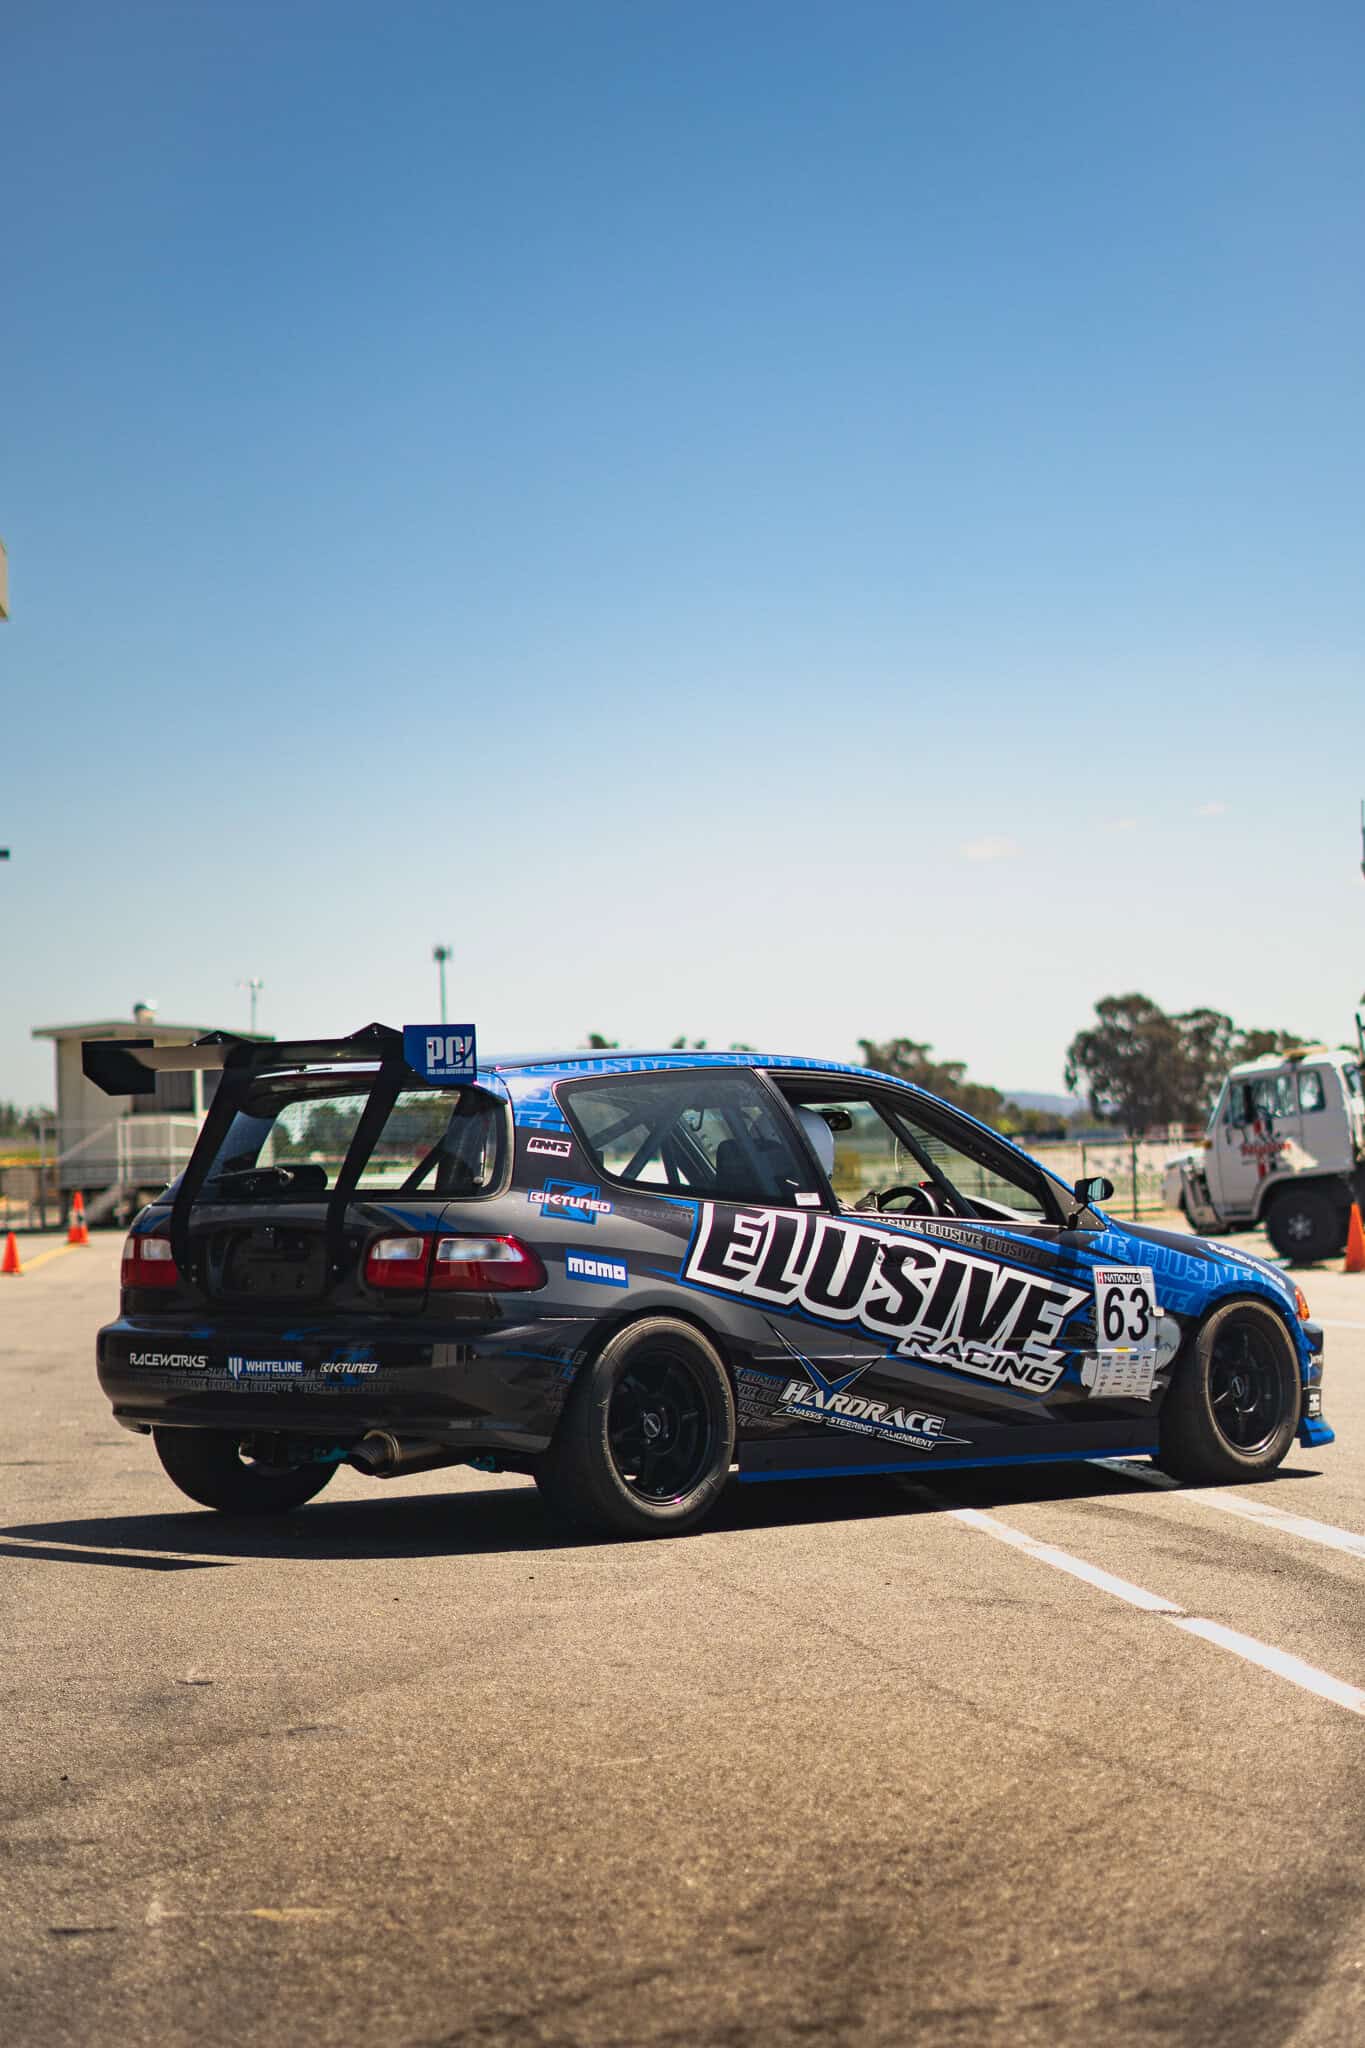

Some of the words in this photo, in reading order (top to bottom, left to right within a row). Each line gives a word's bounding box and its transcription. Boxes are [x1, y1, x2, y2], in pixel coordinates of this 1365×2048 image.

[686, 1202, 1091, 1366] ELUSIVE
[1104, 1273, 1142, 1285] NATIONALS
[1103, 1287, 1150, 1341] 63
[129, 1353, 207, 1368] RACEWORKS
[246, 1361, 303, 1373] WHITELINE
[897, 1331, 1064, 1393] RACING
[780, 1380, 946, 1437] HARDRACE
[786, 1405, 824, 1421] CHASSIS
[829, 1415, 874, 1433] STEERING
[881, 1427, 934, 1448] ALIGNMENT
